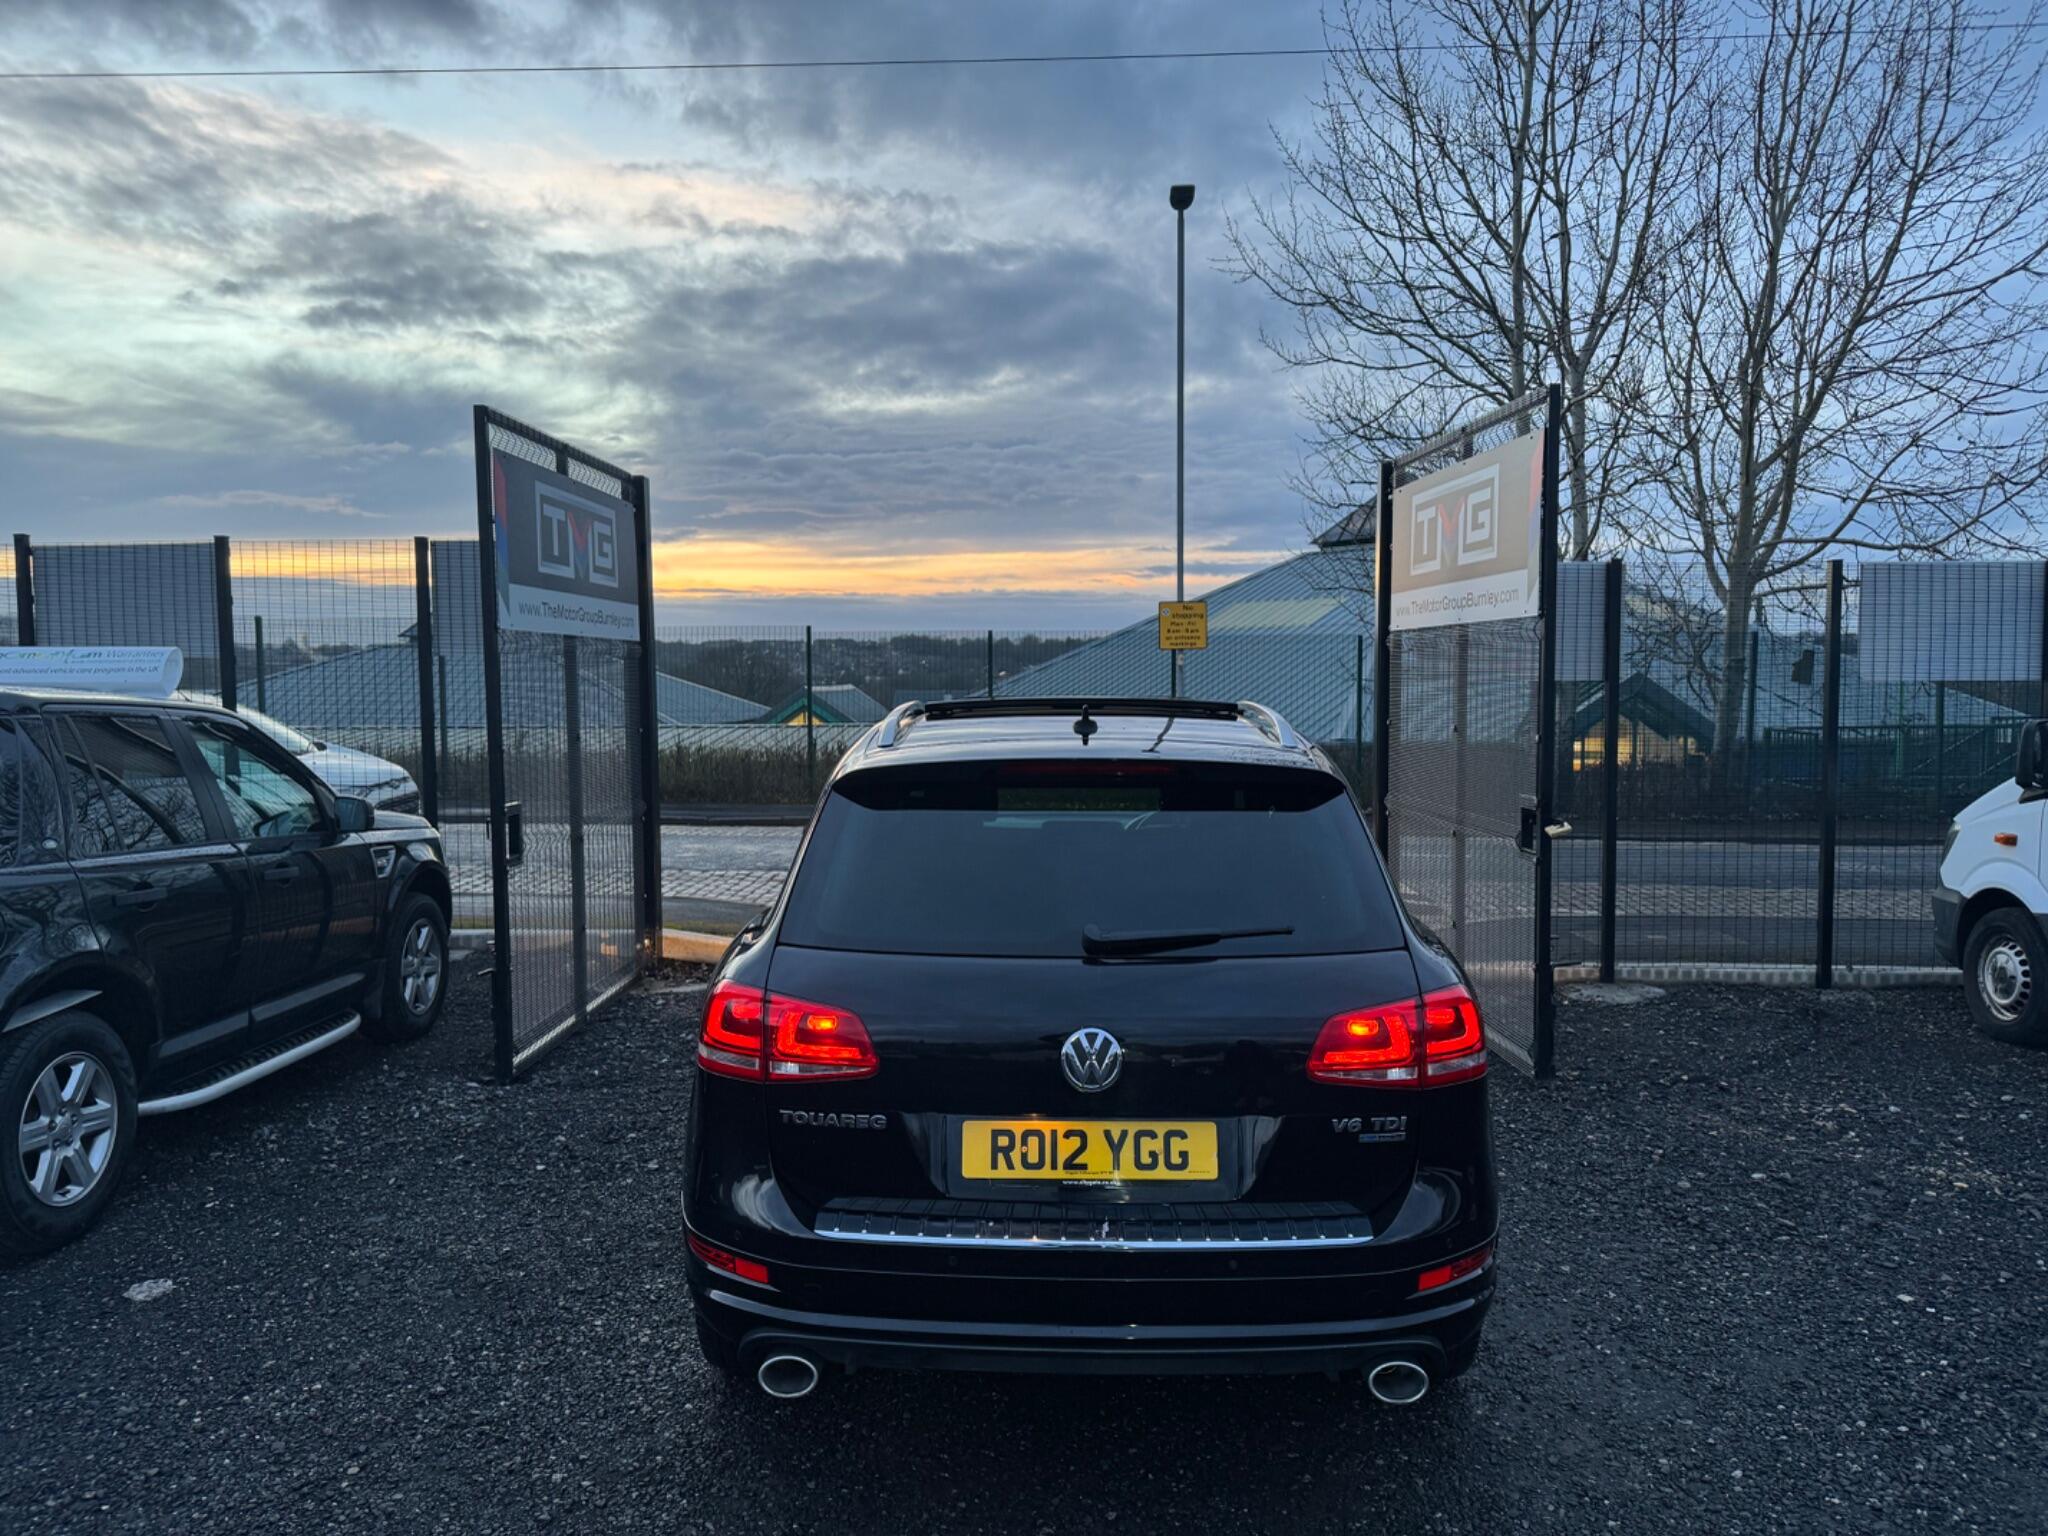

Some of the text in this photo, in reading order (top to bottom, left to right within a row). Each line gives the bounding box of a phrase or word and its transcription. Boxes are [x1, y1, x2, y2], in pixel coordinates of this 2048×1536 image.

[1414, 484, 1493, 570] TMG
[541, 500, 614, 584] TMG
[518, 601, 634, 629] www.TheMotorGroupBurnley.com
[1395, 588, 1520, 616] www.TheMotorGroupBurnley.com
[779, 1109, 887, 1129] TOUAREG
[1331, 1115, 1408, 1133] V6 TDI
[990, 1129, 1190, 1171] RO12 YGG
